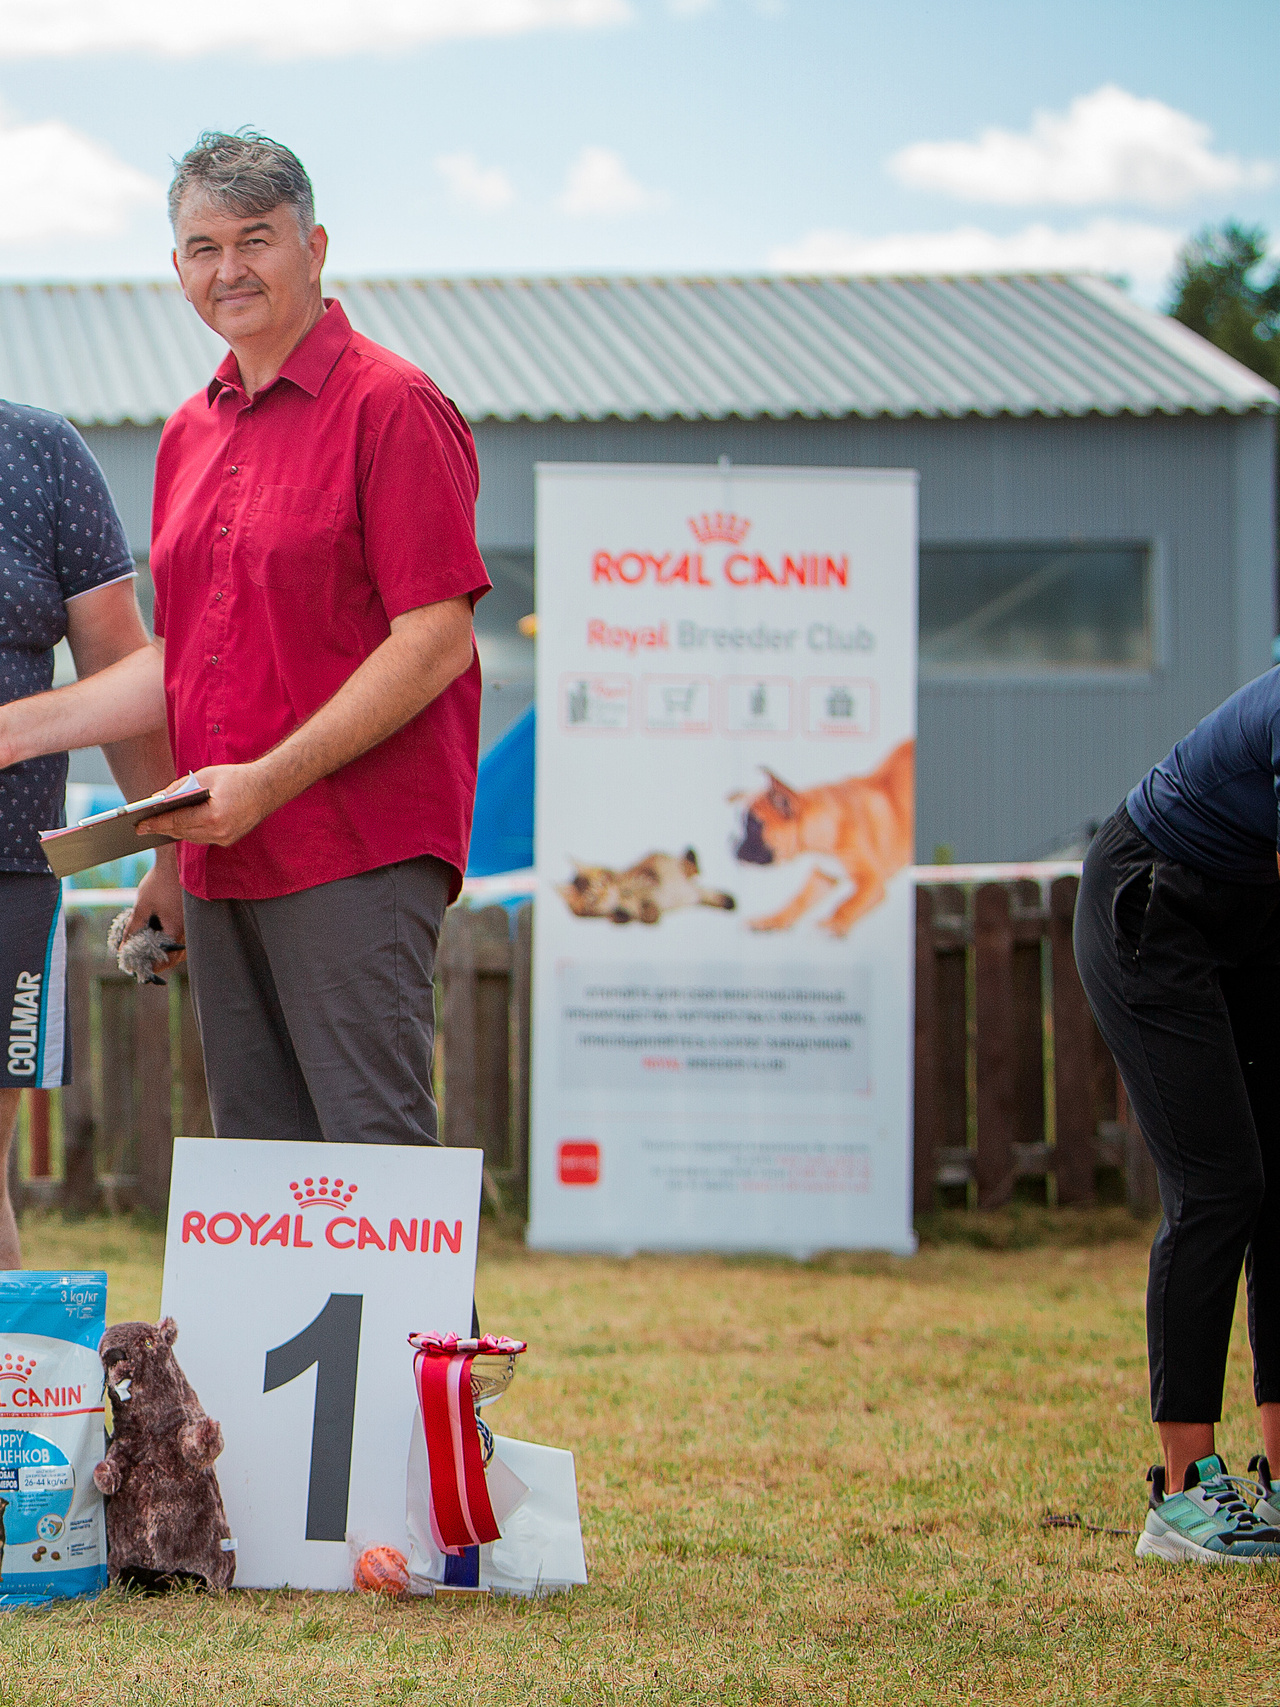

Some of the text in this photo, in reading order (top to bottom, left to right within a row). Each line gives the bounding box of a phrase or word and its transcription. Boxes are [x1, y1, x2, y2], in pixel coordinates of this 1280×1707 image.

[591, 550, 851, 589] ROYAL CANIN
[586, 618, 876, 655] Royal Breeder Club
[7, 971, 42, 1076] COLMAR
[181, 1210, 463, 1254] ROYAL CANIN
[60, 1290, 67, 1303] 3
[11, 1385, 82, 1408] CANIN
[263, 1292, 364, 1542] 1
[24, 1478, 45, 1487] 26-44
